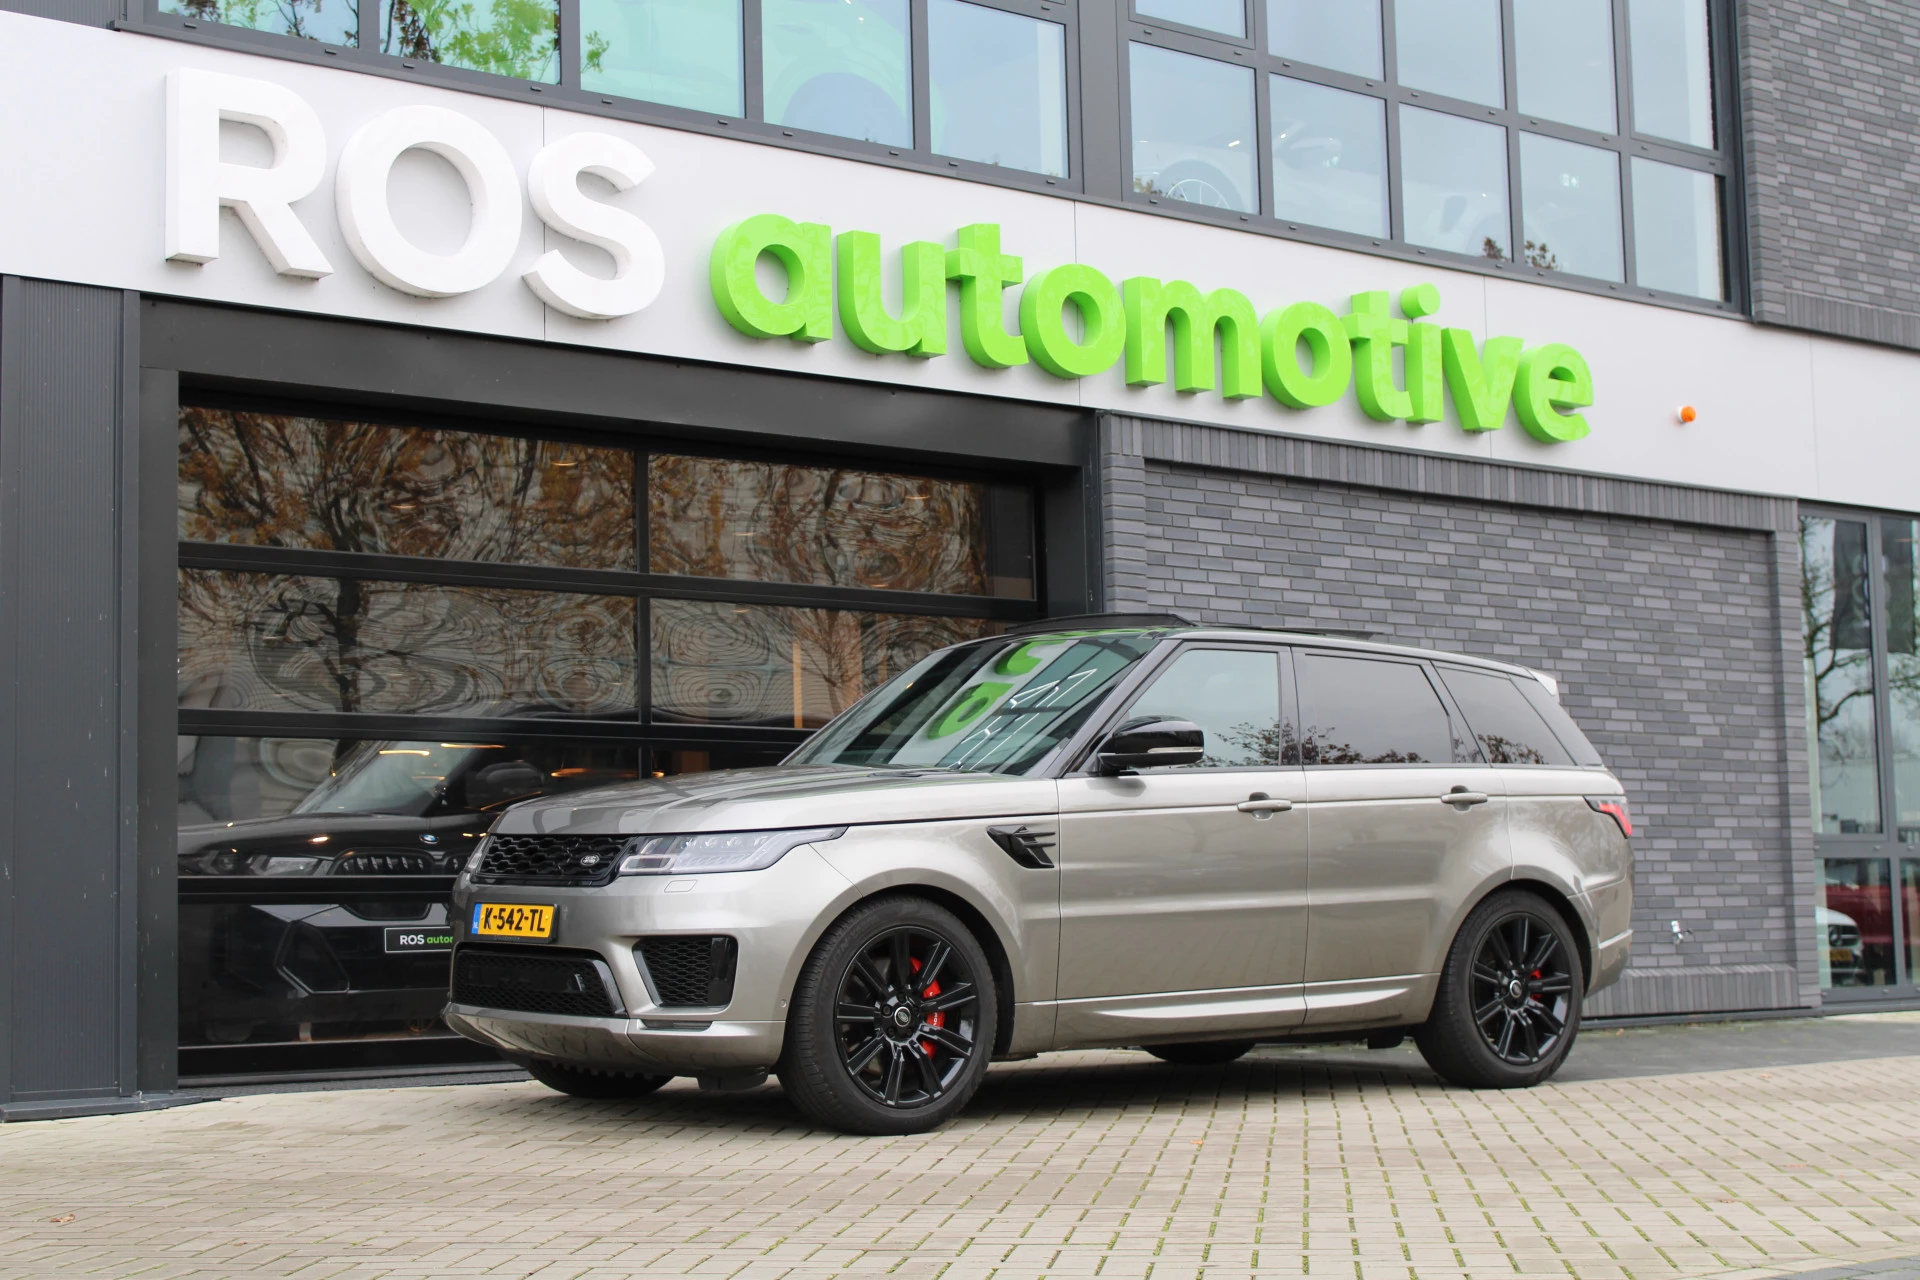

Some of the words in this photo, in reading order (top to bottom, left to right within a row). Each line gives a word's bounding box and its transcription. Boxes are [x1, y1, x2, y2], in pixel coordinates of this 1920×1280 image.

[165, 67, 665, 320] ROS
[709, 213, 1594, 443] automotive
[483, 907, 545, 932] K-542-TL
[400, 934, 425, 945] ROS
